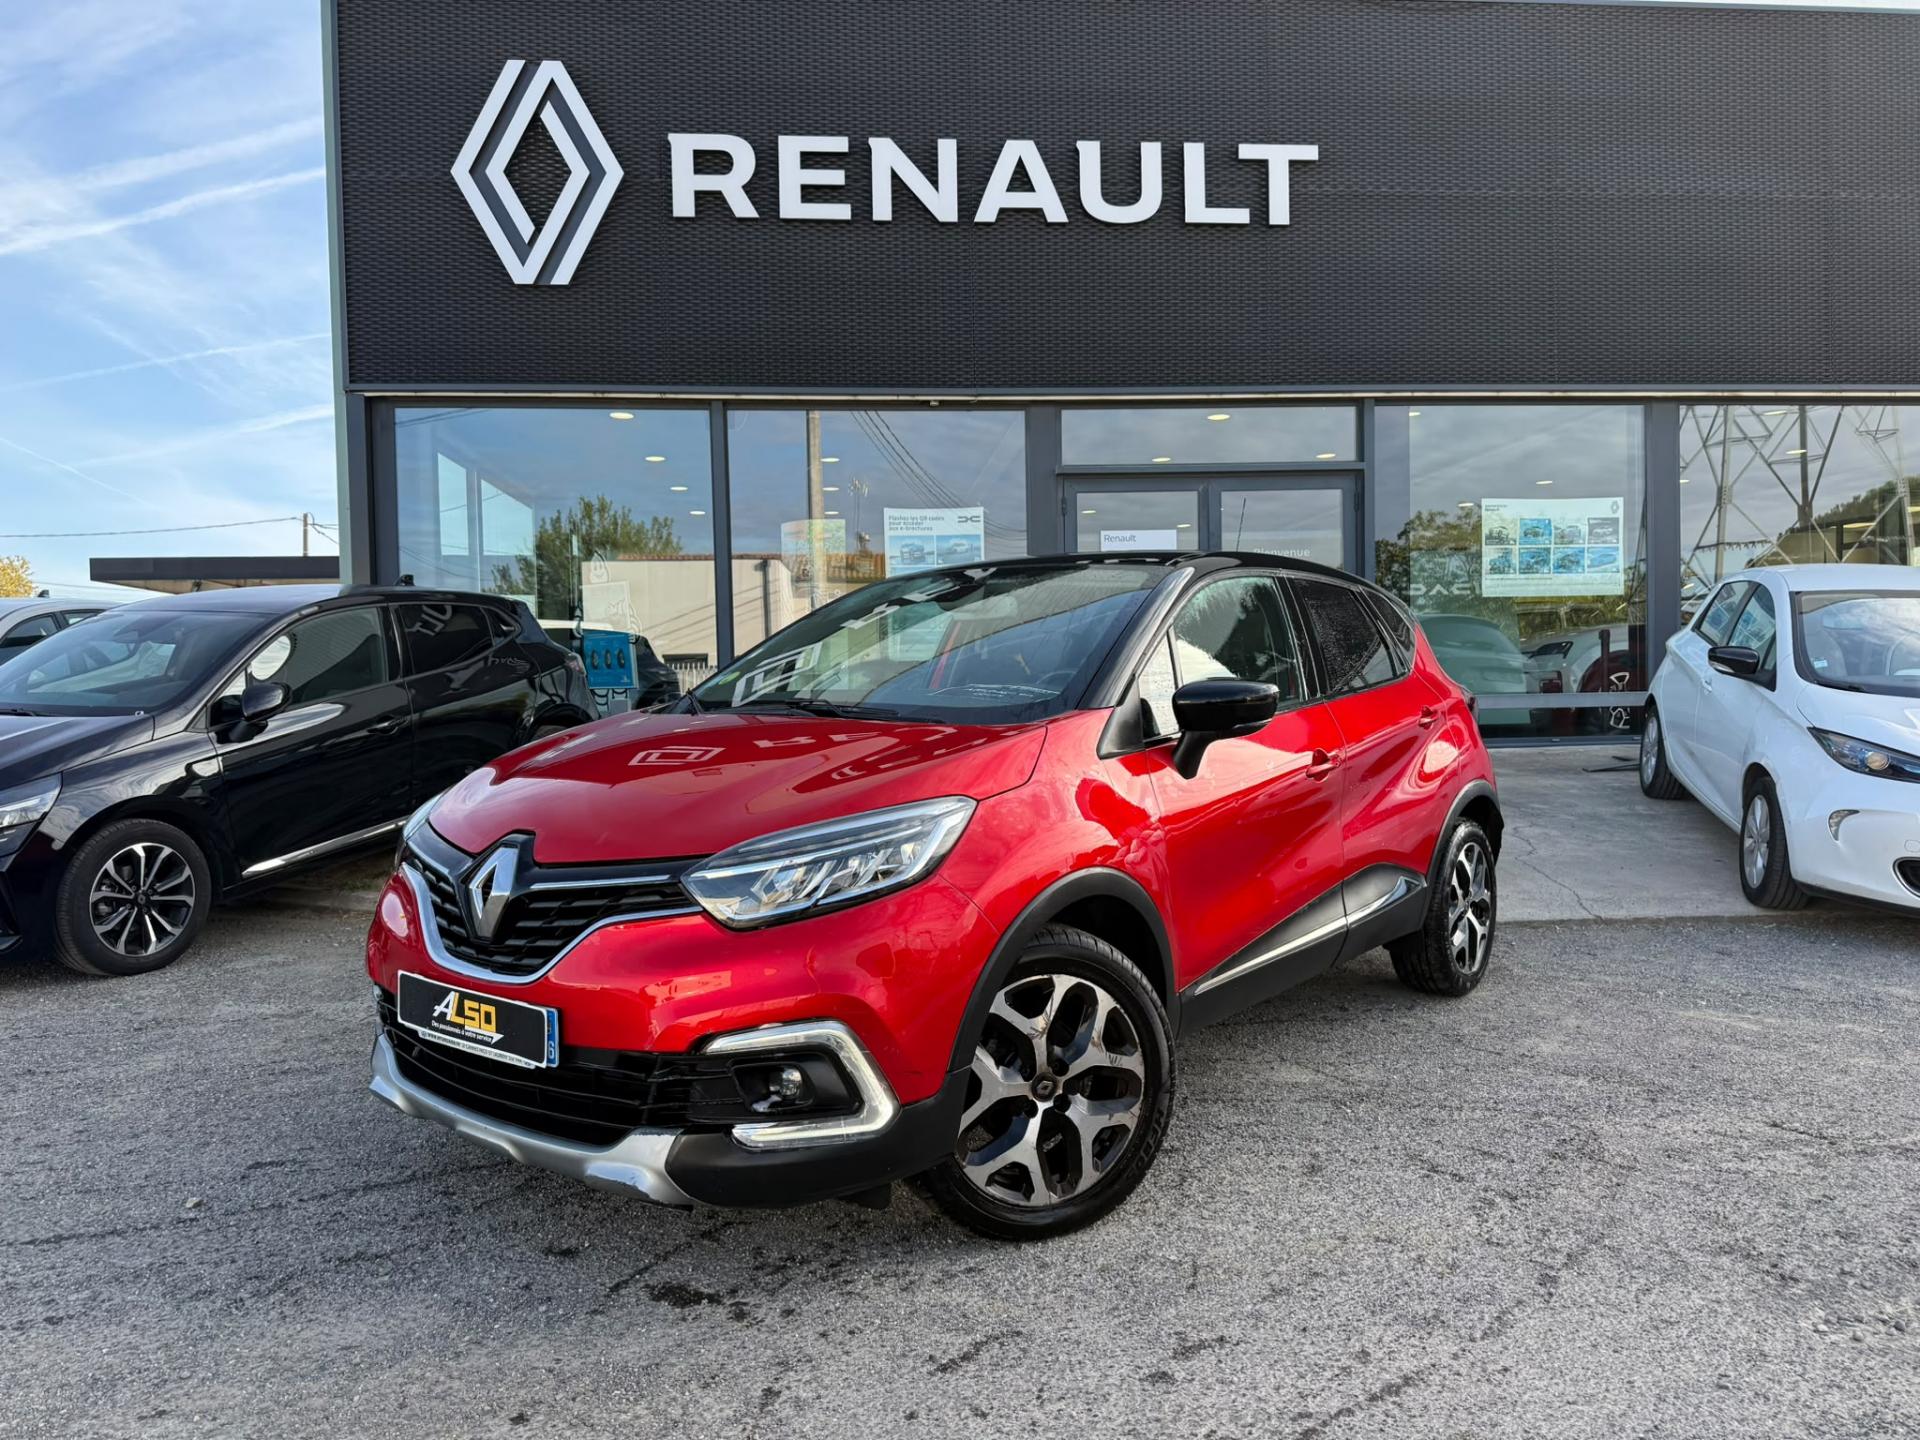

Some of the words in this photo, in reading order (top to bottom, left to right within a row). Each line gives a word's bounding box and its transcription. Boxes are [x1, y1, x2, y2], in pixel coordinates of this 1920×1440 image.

[668, 134, 1318, 226] RENAULT
[1103, 534, 1137, 543] Renault
[1405, 582, 1481, 596] DACI
[432, 991, 496, 1033] ALSO
